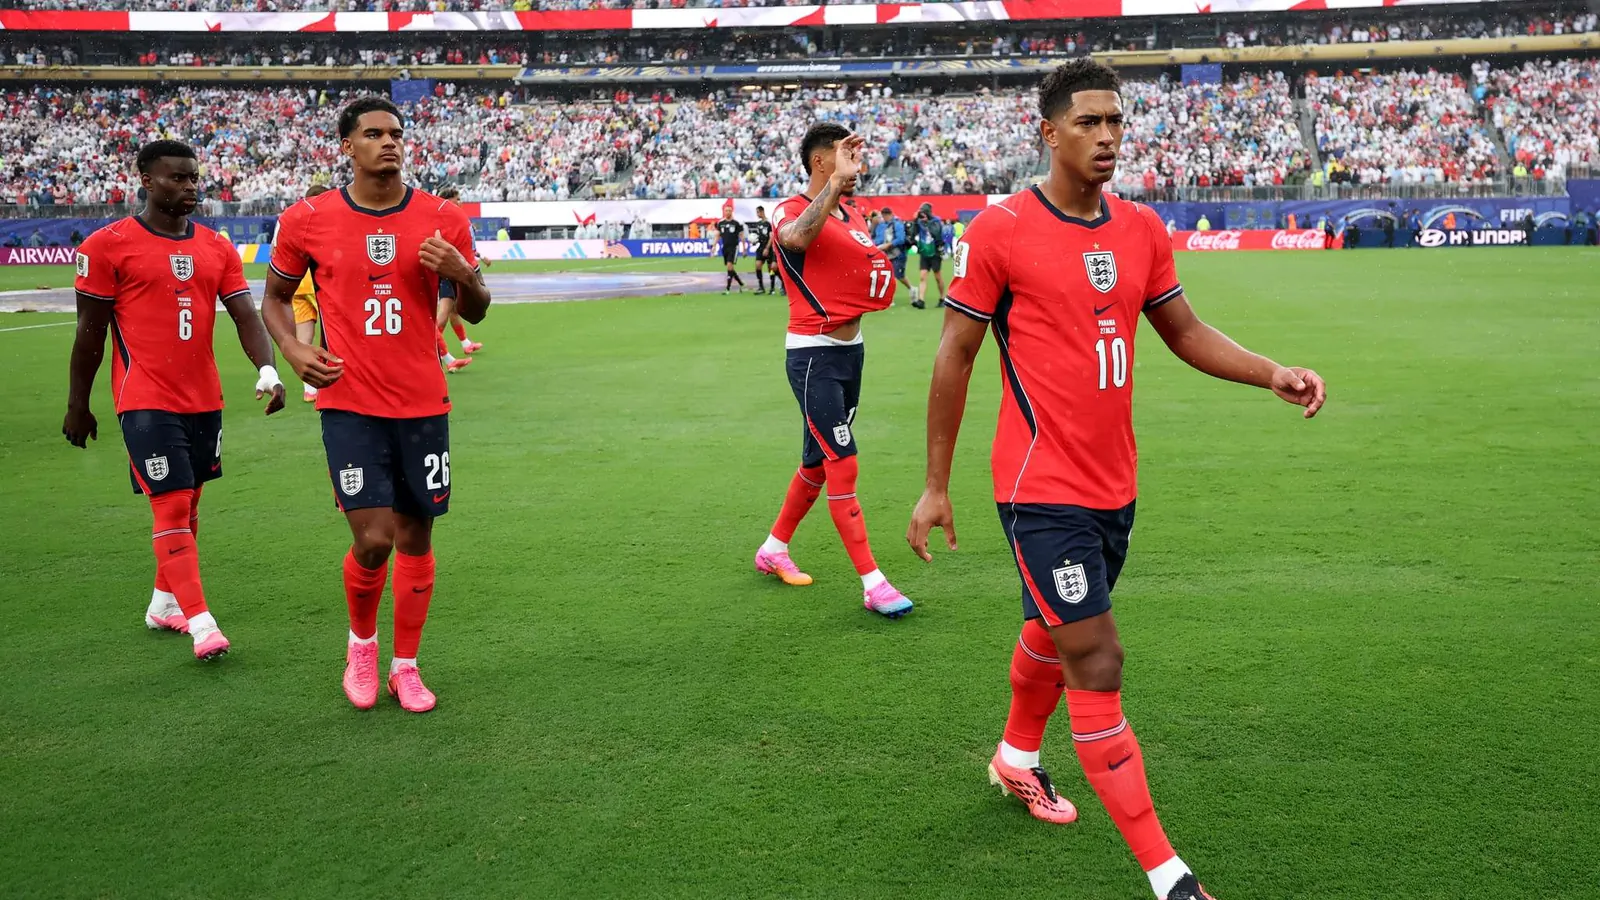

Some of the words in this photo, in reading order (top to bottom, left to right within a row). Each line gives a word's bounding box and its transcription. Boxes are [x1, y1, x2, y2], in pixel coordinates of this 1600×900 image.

[8, 247, 77, 264] AIRWAY
[642, 242, 671, 254] FIFA
[870, 270, 891, 298] 17
[179, 309, 192, 340] 6
[364, 298, 402, 335] 26
[1095, 337, 1127, 390] 10
[424, 451, 450, 490] 26
